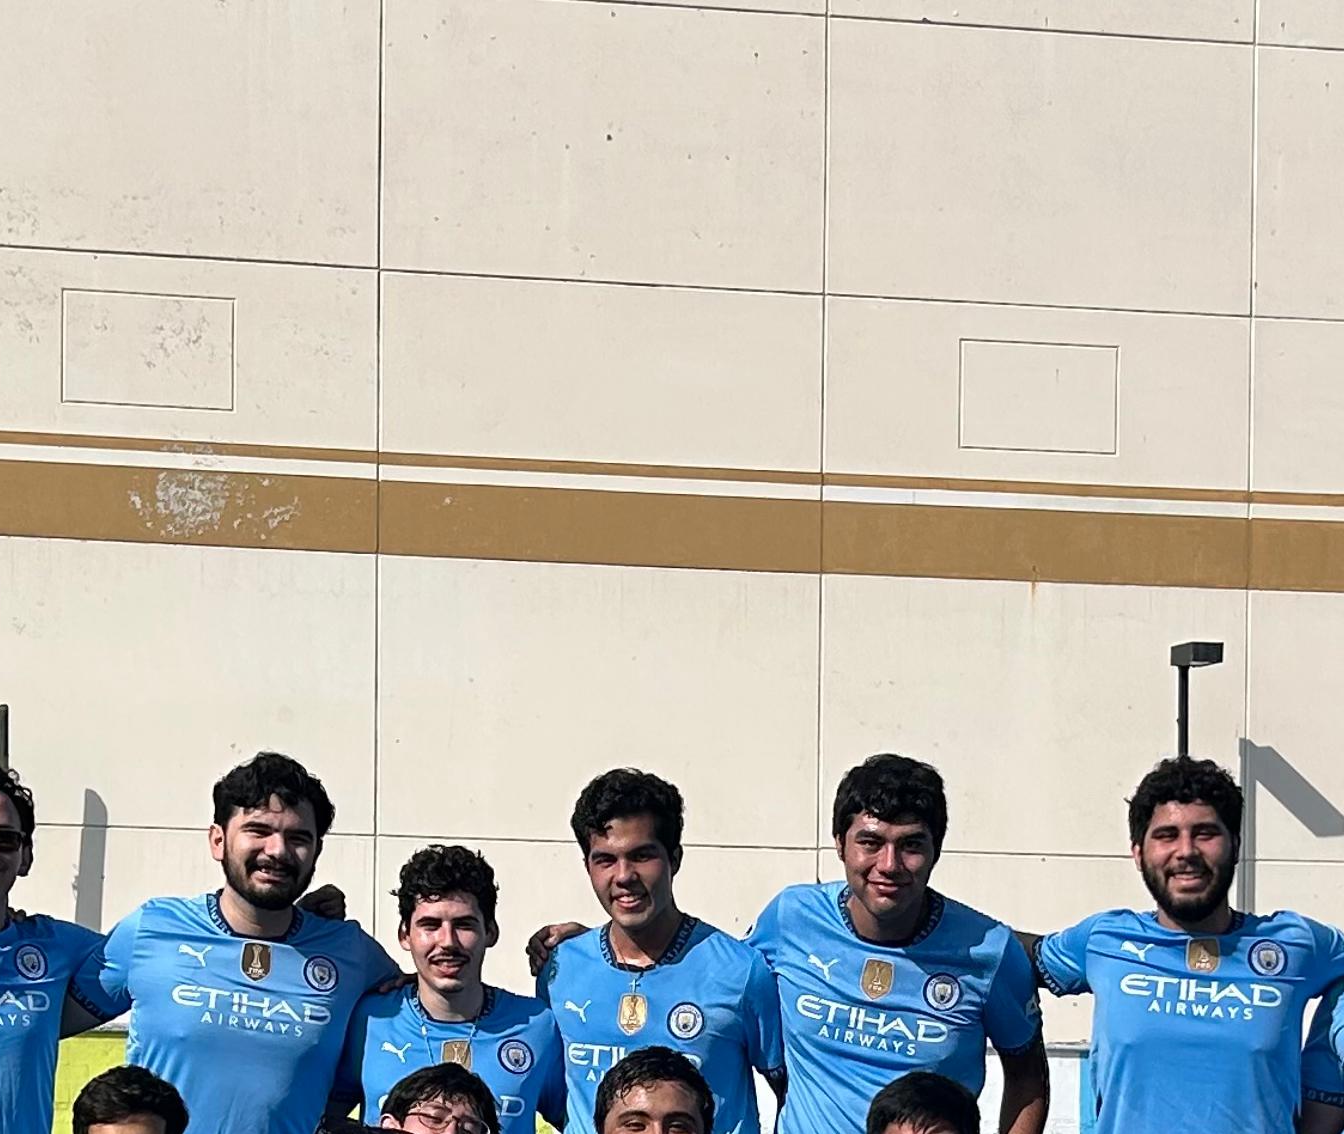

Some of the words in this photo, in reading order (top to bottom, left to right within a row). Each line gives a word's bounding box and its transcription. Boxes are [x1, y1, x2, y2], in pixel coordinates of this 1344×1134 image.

[171, 984, 332, 1026] ETIHAD
[1120, 973, 1282, 1008] ETIHAD
[200, 1011, 304, 1038] AIRWAYS
[796, 994, 949, 1043] ETIHAD
[1148, 1000, 1254, 1020] AIRWAYS
[818, 1024, 916, 1056] AIRWAYS
